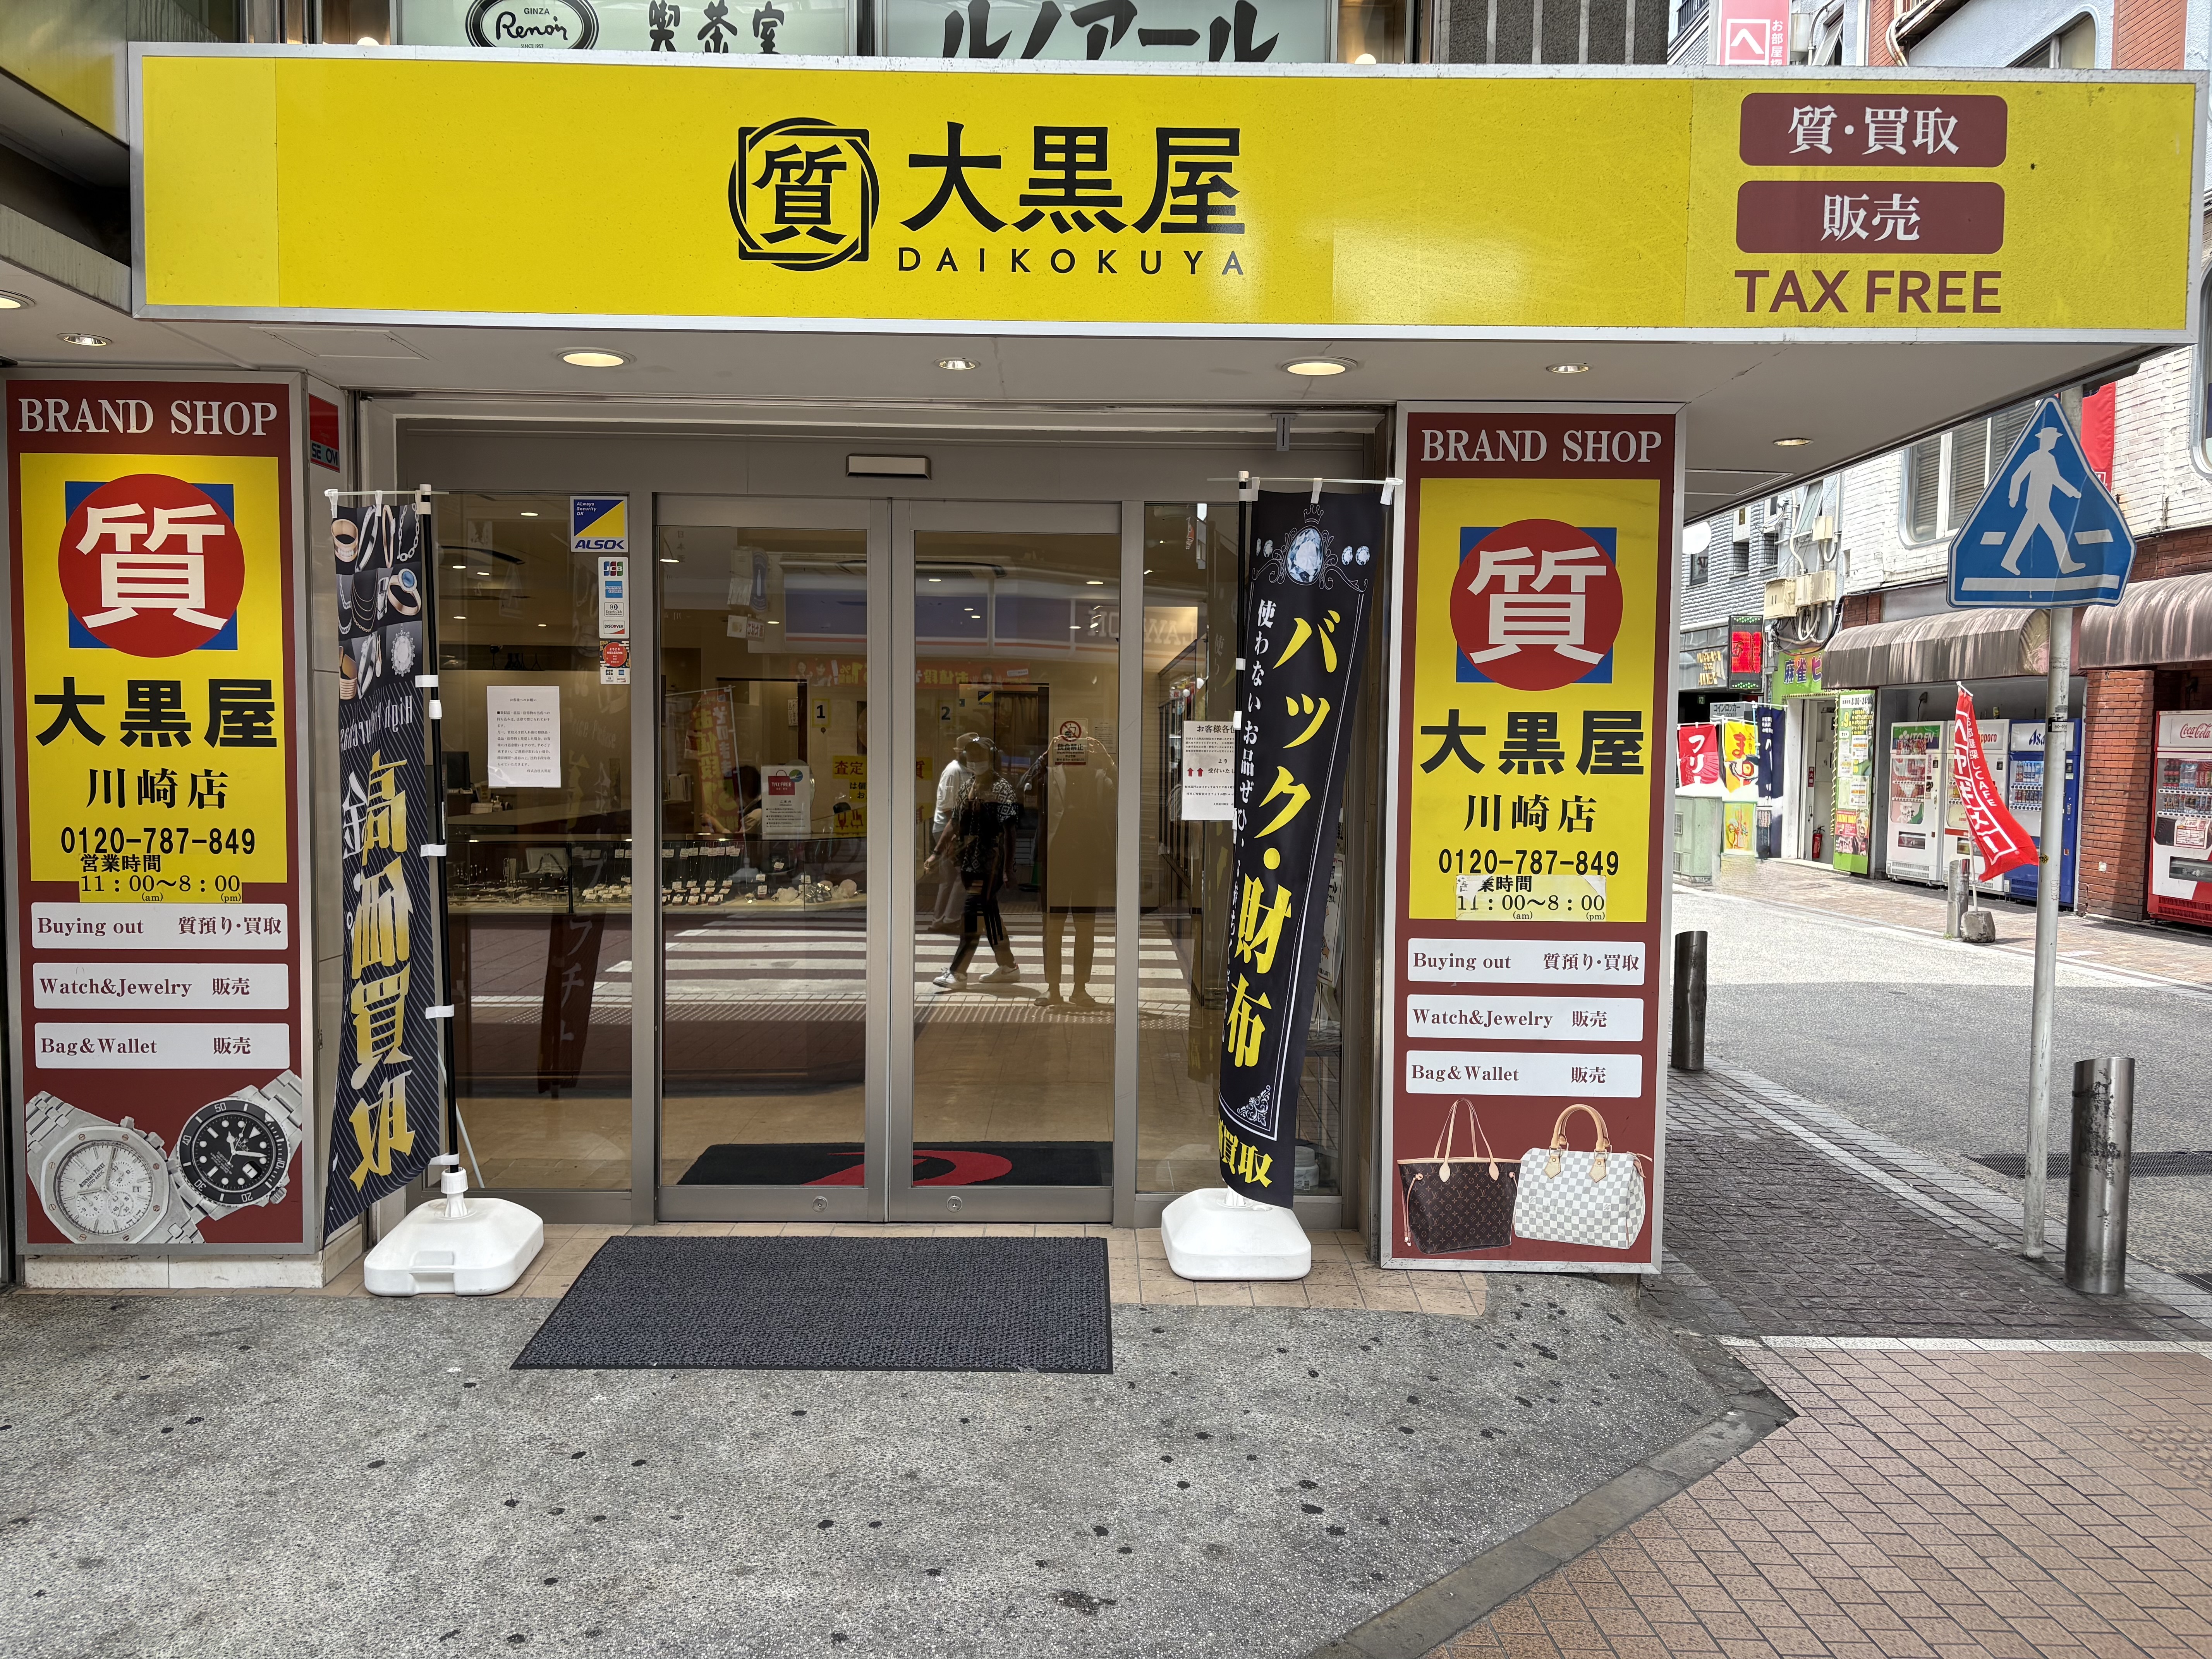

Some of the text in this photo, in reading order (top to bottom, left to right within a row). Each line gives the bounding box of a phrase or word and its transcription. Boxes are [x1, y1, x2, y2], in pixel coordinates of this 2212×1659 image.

[496, 11, 568, 40] Renoir
[649, 0, 785, 54] 喫茶室
[943, 0, 1279, 62] ルノアール
[1788, 105, 1960, 155] 質・買取
[751, 121, 1245, 244] 質 大黒屋
[1820, 193, 1921, 242] 販売
[898, 247, 1244, 276] DAIKOKUYA
[1735, 270, 2002, 314] TAX FREE
[18, 398, 277, 436] BRAND SHOP
[311, 442, 338, 466] SEOM
[1420, 429, 1662, 462] BRAND SHOP
[575, 539, 625, 550] ALSOK
[75, 503, 228, 630] 質
[1467, 546, 1607, 665] 質
[1784, 658, 1807, 685] 麻雀
[34, 677, 277, 748] 大黒屋
[817, 704, 825, 718] 1
[941, 707, 951, 720] 2
[1714, 704, 1741, 712] コインロッカー
[1420, 709, 1644, 775] 大黒屋
[1980, 733, 1997, 744] pporo
[2029, 729, 2045, 745] Asa
[834, 760, 864, 775] 査定
[86, 767, 228, 809] 川崎店
[1463, 793, 1597, 833] 川崎店
[61, 827, 256, 855] 0120-787-849
[1226, 610, 1340, 1068] バック・財布
[80, 854, 161, 873] 営業時間
[1439, 849, 1619, 876] 0120-787-849
[142, 892, 241, 903] (am) (pm)
[37, 916, 282, 937] Buying out 質預り・買取
[1513, 911, 1605, 921] (am) (pm)
[1413, 953, 1639, 971] Buying out 質預り・買取
[39, 977, 250, 998] Watch&Jewelry 販売
[1413, 1009, 1607, 1028] Watch&Jewelry 販売
[41, 1036, 251, 1056] Bag&Wallet 販売
[1412, 1065, 1606, 1084] Bag&Wallet 販売
[215, 1103, 226, 1113] 50
[182, 1135, 192, 1146] 40
[275, 1160, 285, 1169] 10
[194, 1179, 206, 1192] 30
[241, 1192, 253, 1202] 20
